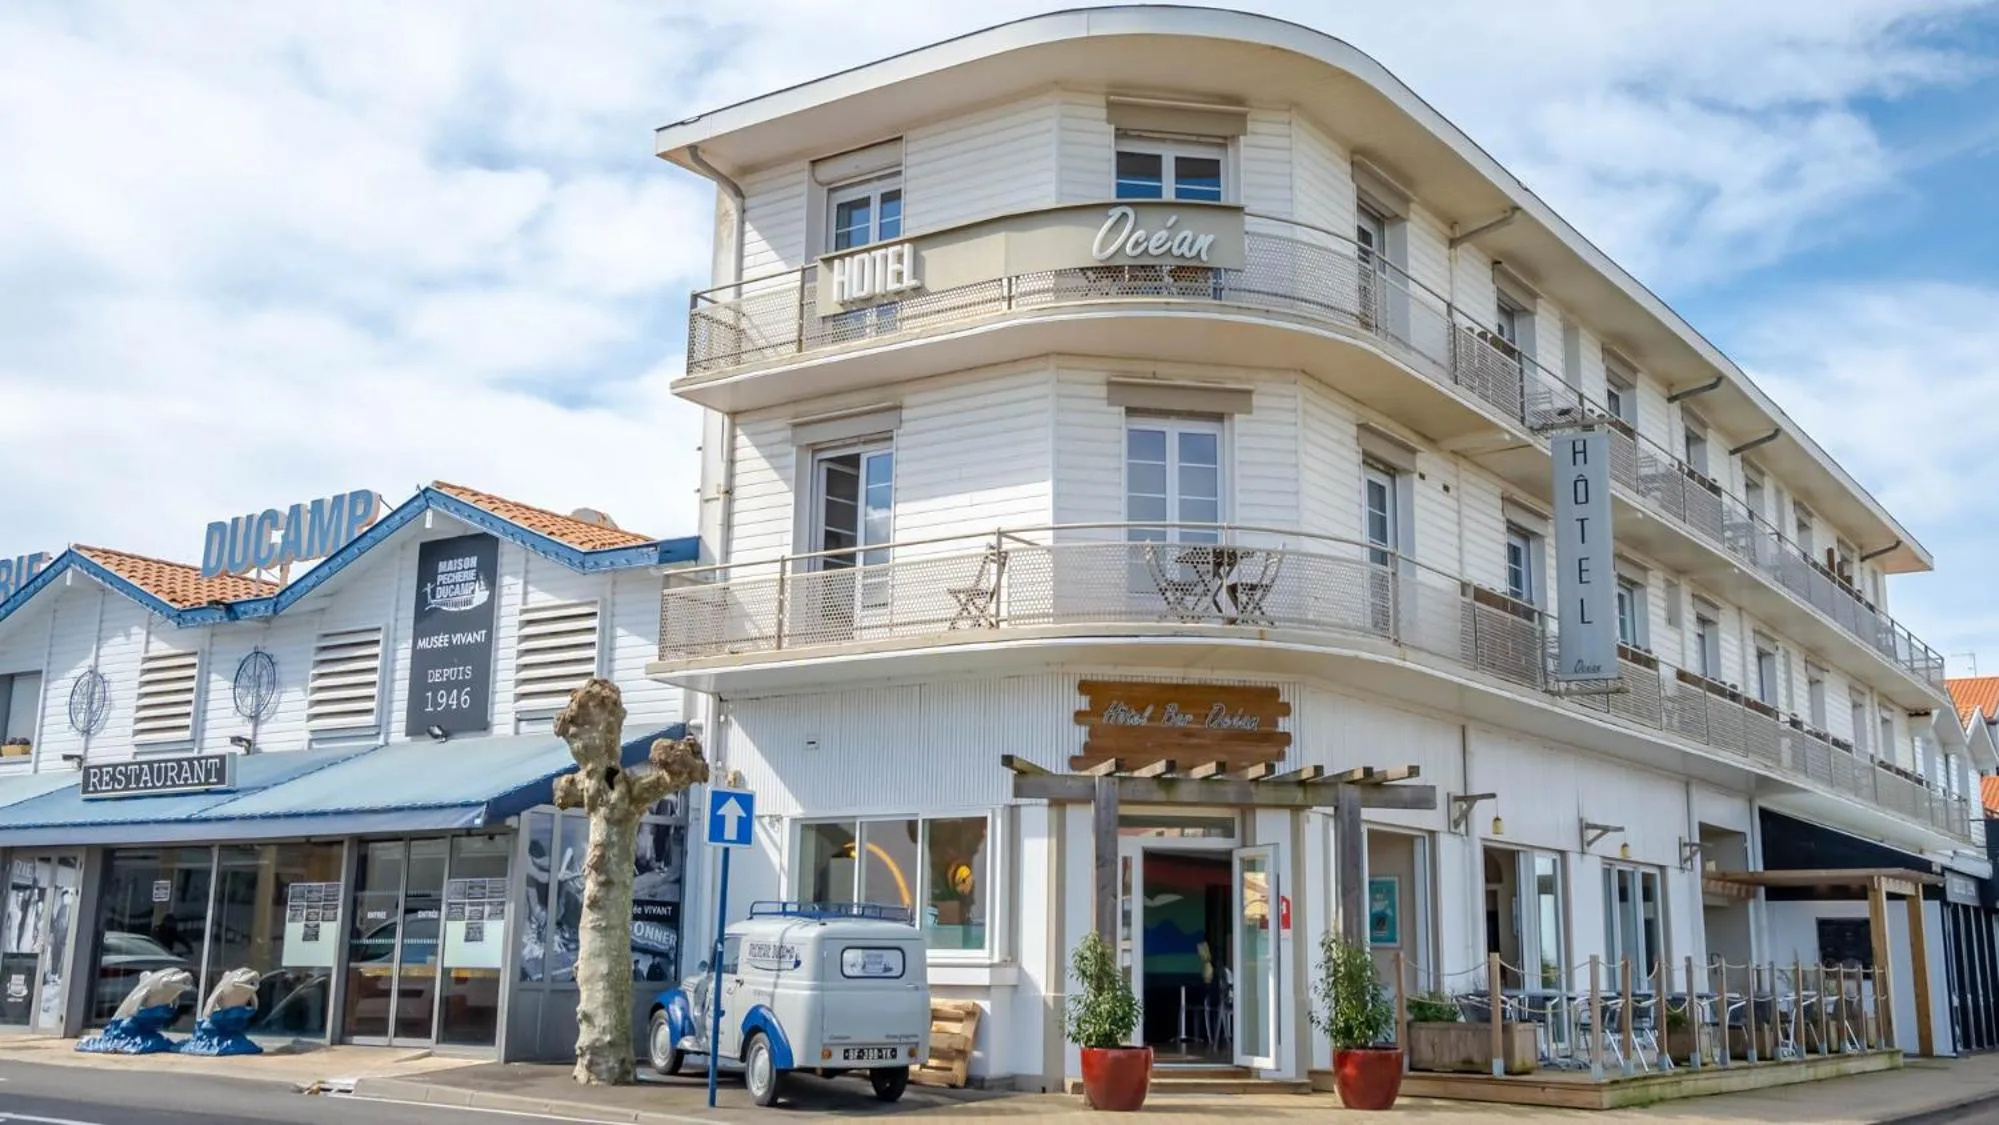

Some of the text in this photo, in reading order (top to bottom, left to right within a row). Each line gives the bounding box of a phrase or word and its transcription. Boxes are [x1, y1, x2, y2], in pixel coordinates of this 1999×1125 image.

[1091, 205, 1216, 263] Océan
[832, 244, 921, 304] HOTEL
[202, 489, 380, 577] DUCAMP
[1571, 438, 1594, 625] HÔTEL
[438, 556, 477, 573] MAISON
[436, 583, 475, 599] DUCAMP
[417, 630, 487, 650] MUSÉE VIVANT
[427, 666, 472, 682] DEPUIS
[425, 687, 471, 712] 1946
[88, 758, 220, 792] RESTAURANT
[643, 904, 672, 916] VIVANT
